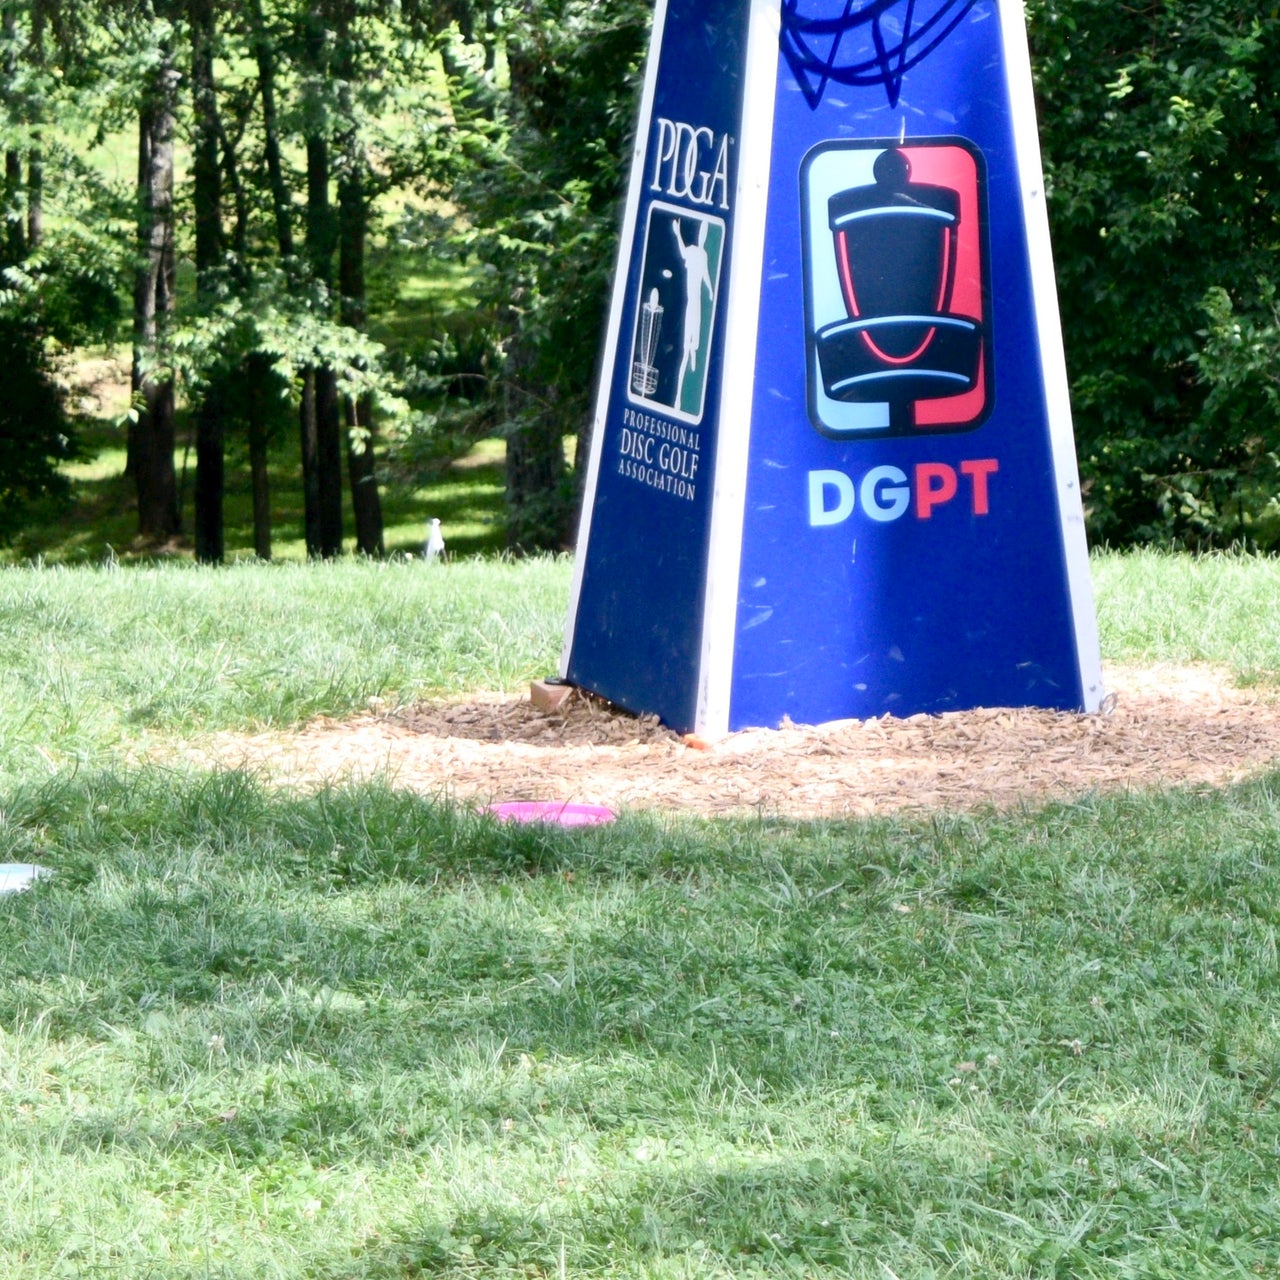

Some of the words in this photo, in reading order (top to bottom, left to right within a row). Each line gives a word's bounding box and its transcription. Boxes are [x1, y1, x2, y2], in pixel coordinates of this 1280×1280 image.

[650, 117, 730, 210] PDGA
[620, 428, 655, 464] DISC
[659, 443, 699, 479] GOLF
[623, 407, 700, 450] PROFESSIONAL
[617, 458, 696, 501] ASSOCIATION
[808, 458, 999, 526] DGPT
